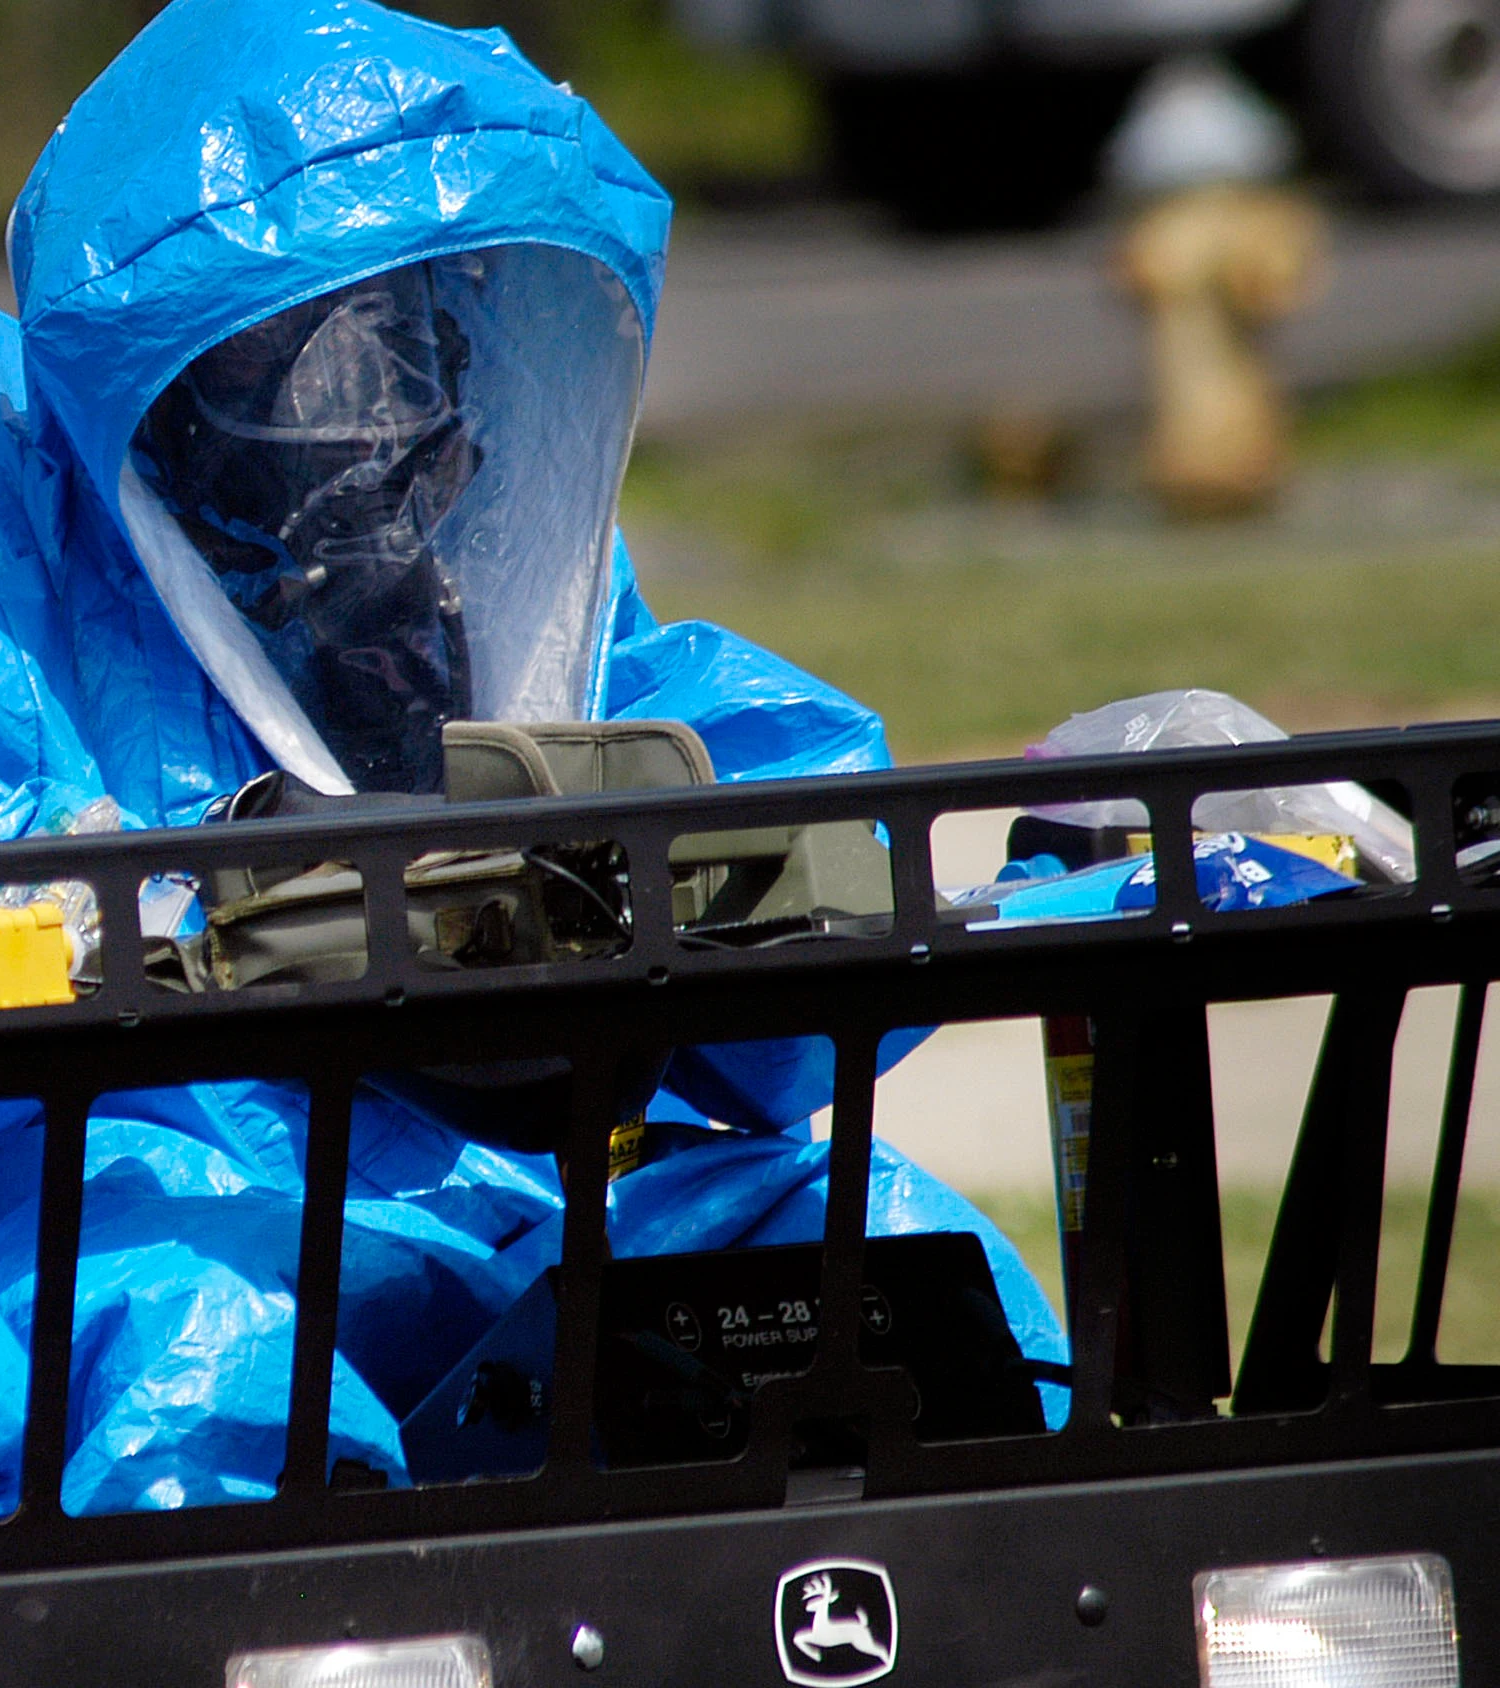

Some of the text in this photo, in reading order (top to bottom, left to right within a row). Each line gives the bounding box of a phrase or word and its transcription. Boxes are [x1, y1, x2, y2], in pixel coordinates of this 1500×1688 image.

[718, 1305, 749, 1329] 24
[779, 1301, 811, 1324] 28
[722, 1327, 818, 1348] POWER SUP
